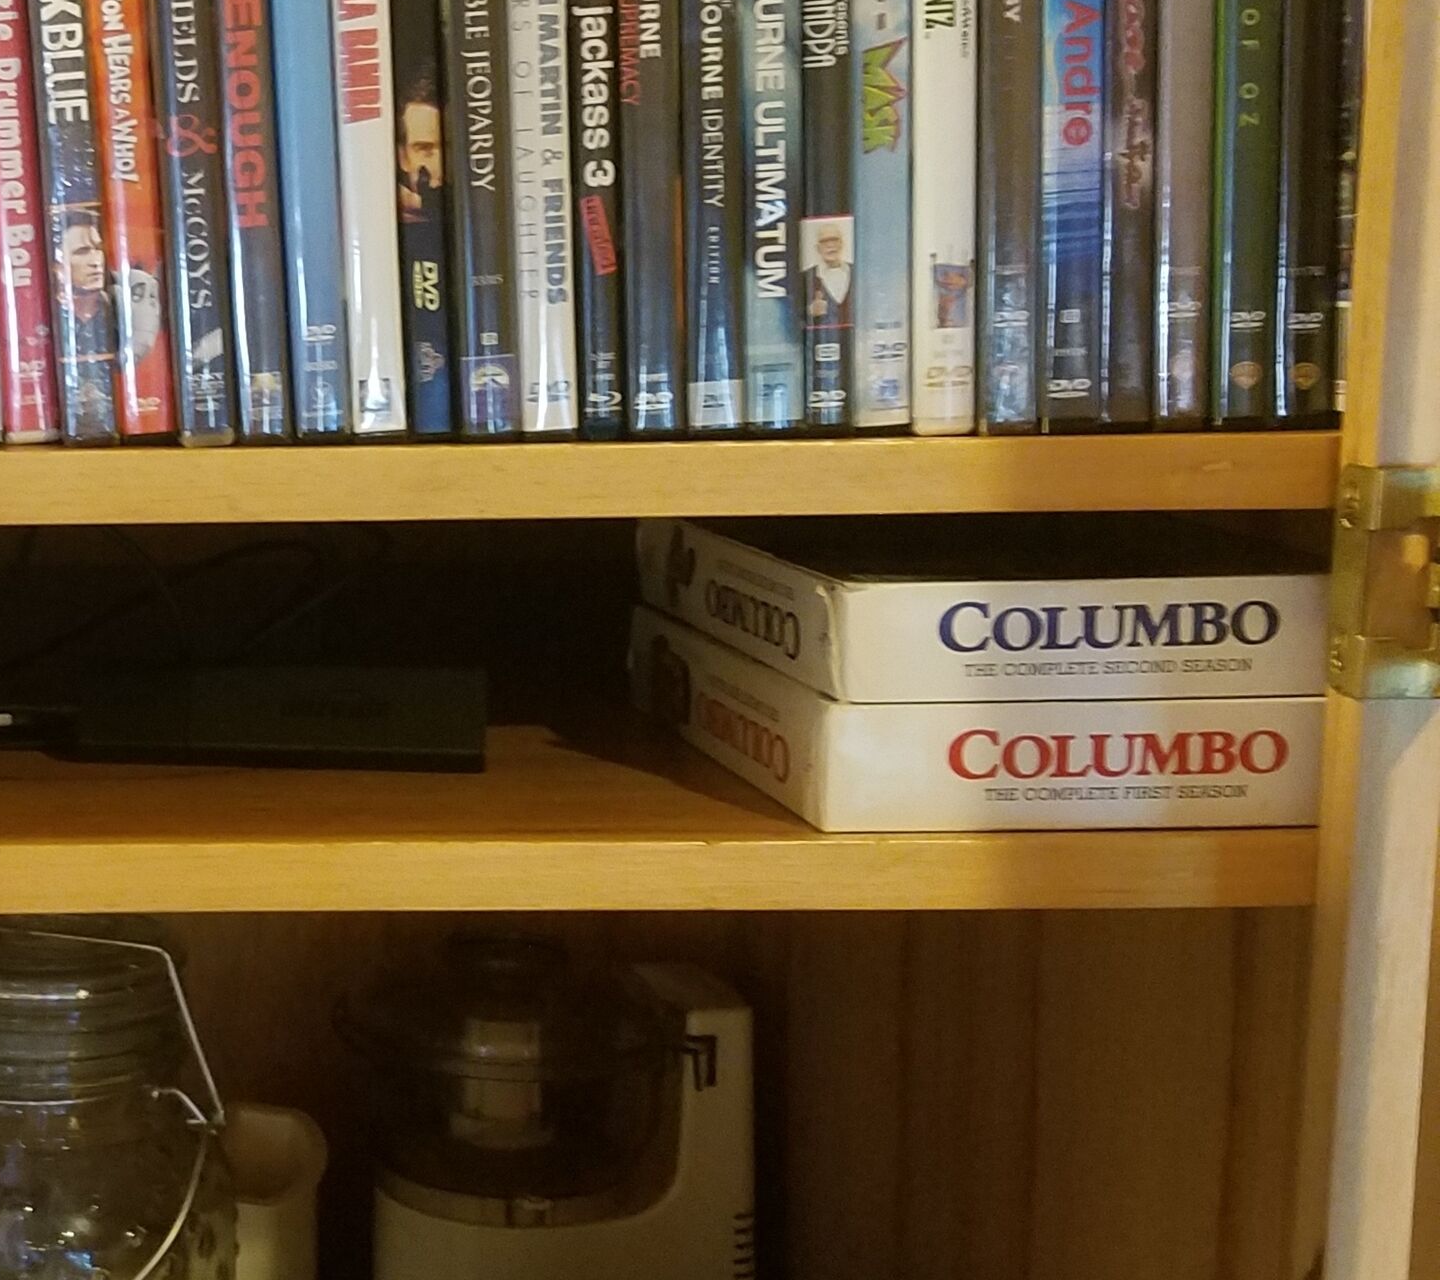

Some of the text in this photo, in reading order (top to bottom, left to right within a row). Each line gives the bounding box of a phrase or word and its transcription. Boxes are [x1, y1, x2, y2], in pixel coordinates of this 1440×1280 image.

[1241, 8, 1261, 47] OF
[42, 22, 90, 125] BLUE
[101, 33, 135, 105] HEARS
[339, 28, 381, 124] BAMBA
[511, 61, 536, 98] OF
[537, 14, 563, 137] MARTIN
[1063, 0, 1102, 146] Andre
[460, 50, 495, 191] JEOPARDY
[1239, 83, 1261, 127] OZ
[110, 120, 139, 184] WHO!
[541, 148, 562, 166] &
[583, 160, 615, 187] 3
[701, 108, 725, 208] IDENTITY
[754, 100, 788, 299] ULTIMATUM
[2, 224, 35, 287] Boy
[542, 178, 567, 305] FRIENDS
[421, 261, 440, 312] DVD
[937, 600, 1282, 653] COLUMBO
[965, 657, 1254, 677] THE COMPLETE SECOND SEASON
[947, 728, 1291, 780] COLUMBO
[984, 784, 1249, 801] THE COMPLETE FIRST SEASON
